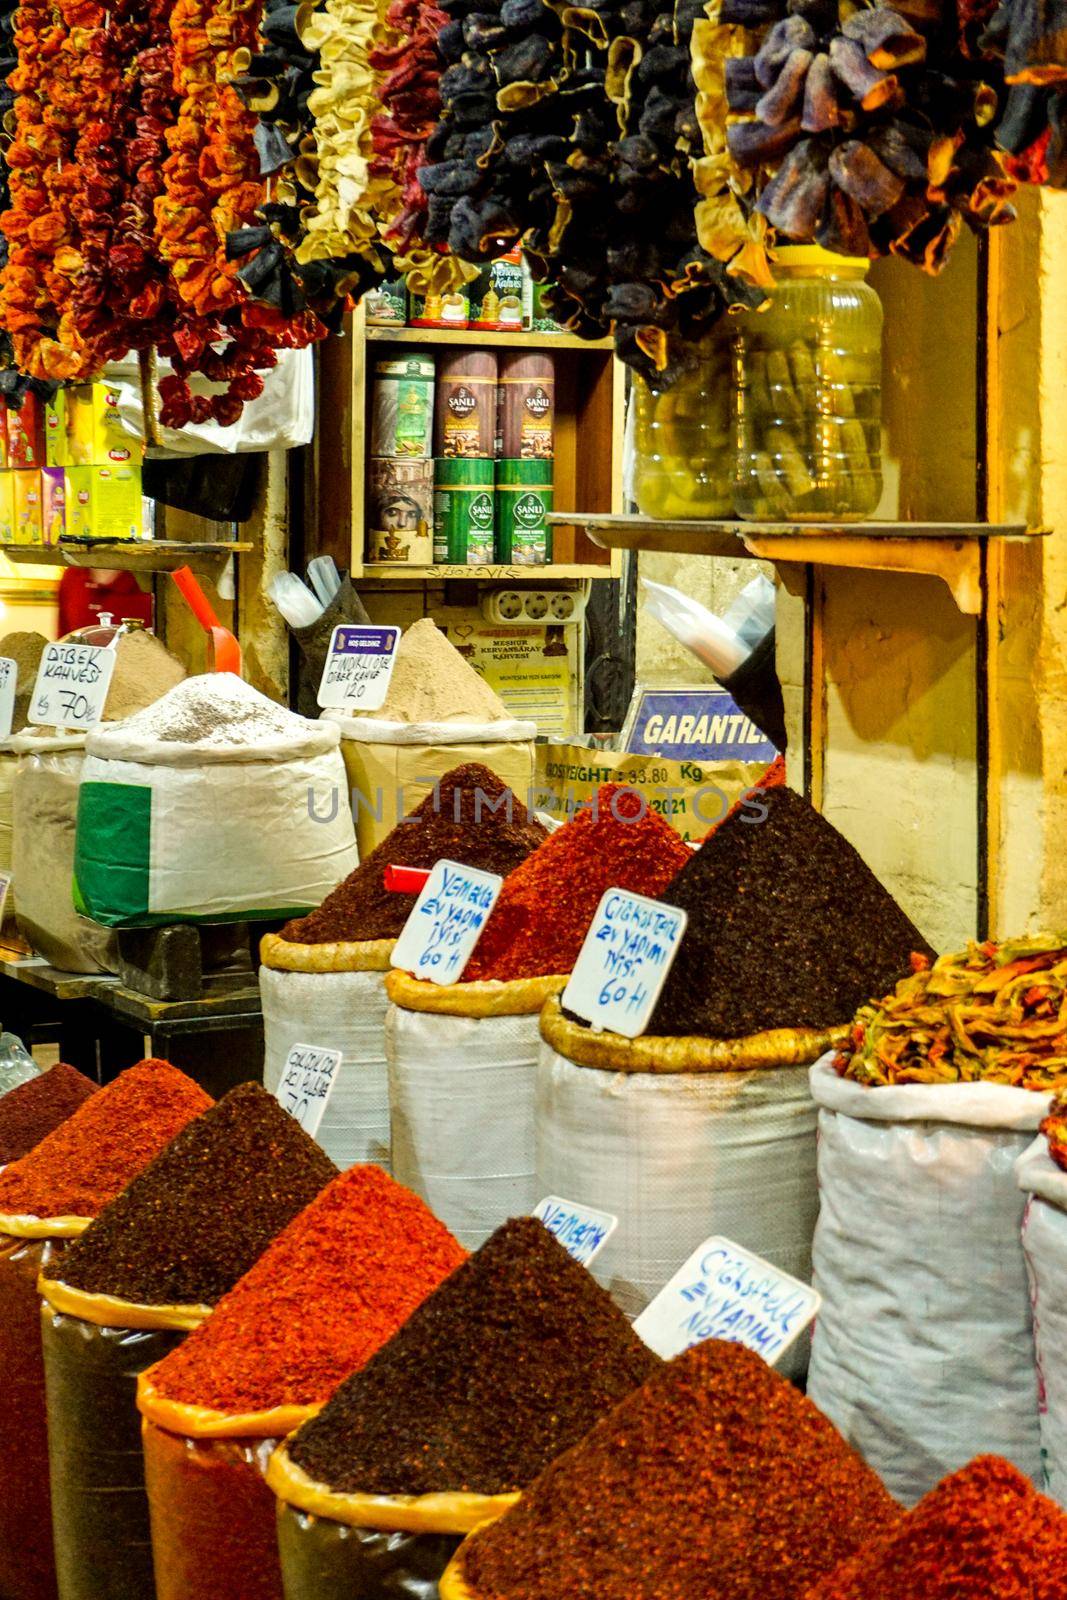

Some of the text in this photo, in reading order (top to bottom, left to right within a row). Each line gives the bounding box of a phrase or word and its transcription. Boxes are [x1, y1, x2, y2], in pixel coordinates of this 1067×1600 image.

[343, 682, 366, 699] 120
[643, 714, 768, 744] GARANTIL
[680, 762, 703, 782] Kg
[598, 978, 627, 1006] 60
